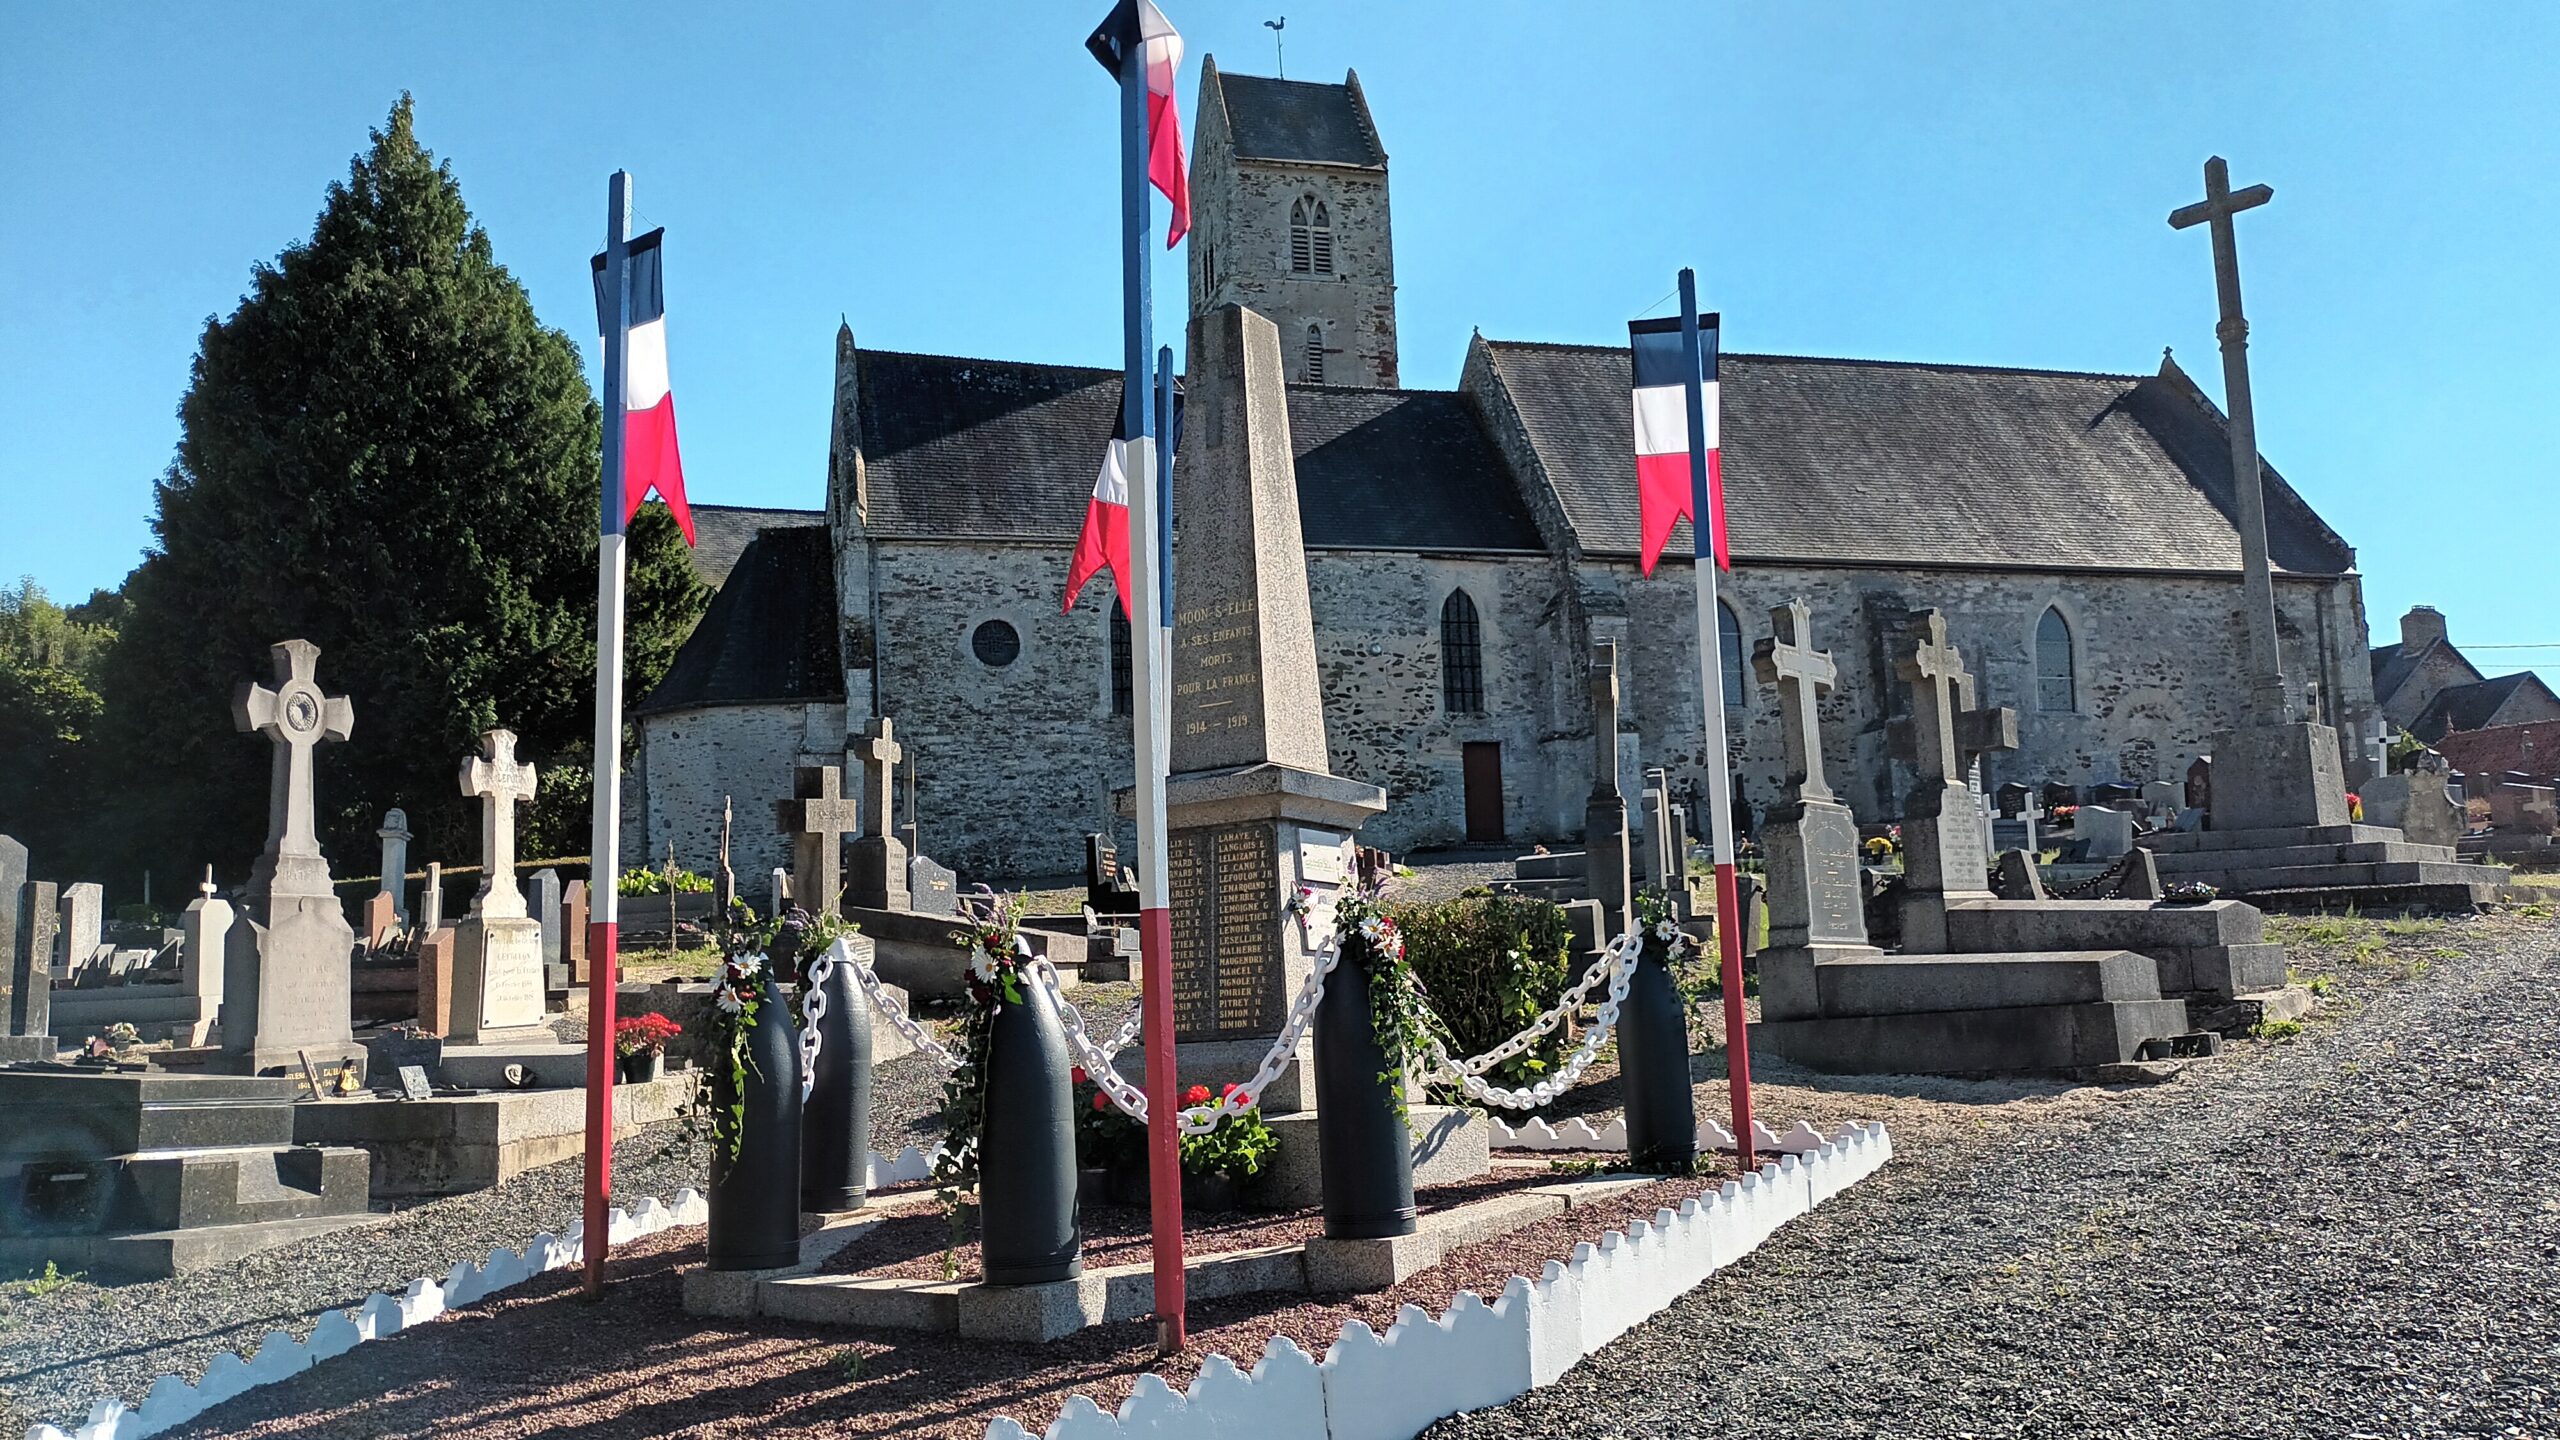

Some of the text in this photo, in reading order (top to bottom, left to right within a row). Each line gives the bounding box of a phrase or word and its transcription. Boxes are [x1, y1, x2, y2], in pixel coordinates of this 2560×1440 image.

[1191, 634, 1209, 646] SES
[1213, 625, 1253, 643] ENFANTS
[1200, 653, 1233, 668] MORTS
[1177, 673, 1257, 696] POUR LA FRANCE
[1186, 721, 1208, 736] 1914
[1227, 714, 1249, 729] 1919
[1218, 832, 1250, 843] LAHAYE
[1169, 840, 1183, 849] LIX
[1218, 842, 1256, 854] LANGLOIS
[1169, 850, 1183, 859] LIX
[1168, 859, 1193, 869] RNARD
[1219, 864, 1229, 873] LE
[1168, 870, 1193, 879] RNARD
[1219, 872, 1258, 884] LEFOULON
[1169, 879, 1193, 889] PELLE
[1219, 882, 1266, 895] LEMARQUAND
[1170, 889, 1196, 899] ARLES
[1219, 903, 1259, 915] LEMOIGNE
[1219, 925, 1250, 935] LENOIR
[1219, 934, 1263, 946] LESELLIER
[1219, 945, 1263, 957] MALHERBE
[1219, 955, 1264, 967] MAUGENDRE
[1219, 966, 1253, 977] MARCEL
[1219, 977, 1257, 988] PIGNOLET
[1219, 988, 1252, 999] POIRIER
[1219, 999, 1249, 1008] PITREY
[1219, 1009, 1249, 1019] SIMION
[1219, 1020, 1248, 1030] SIMION
